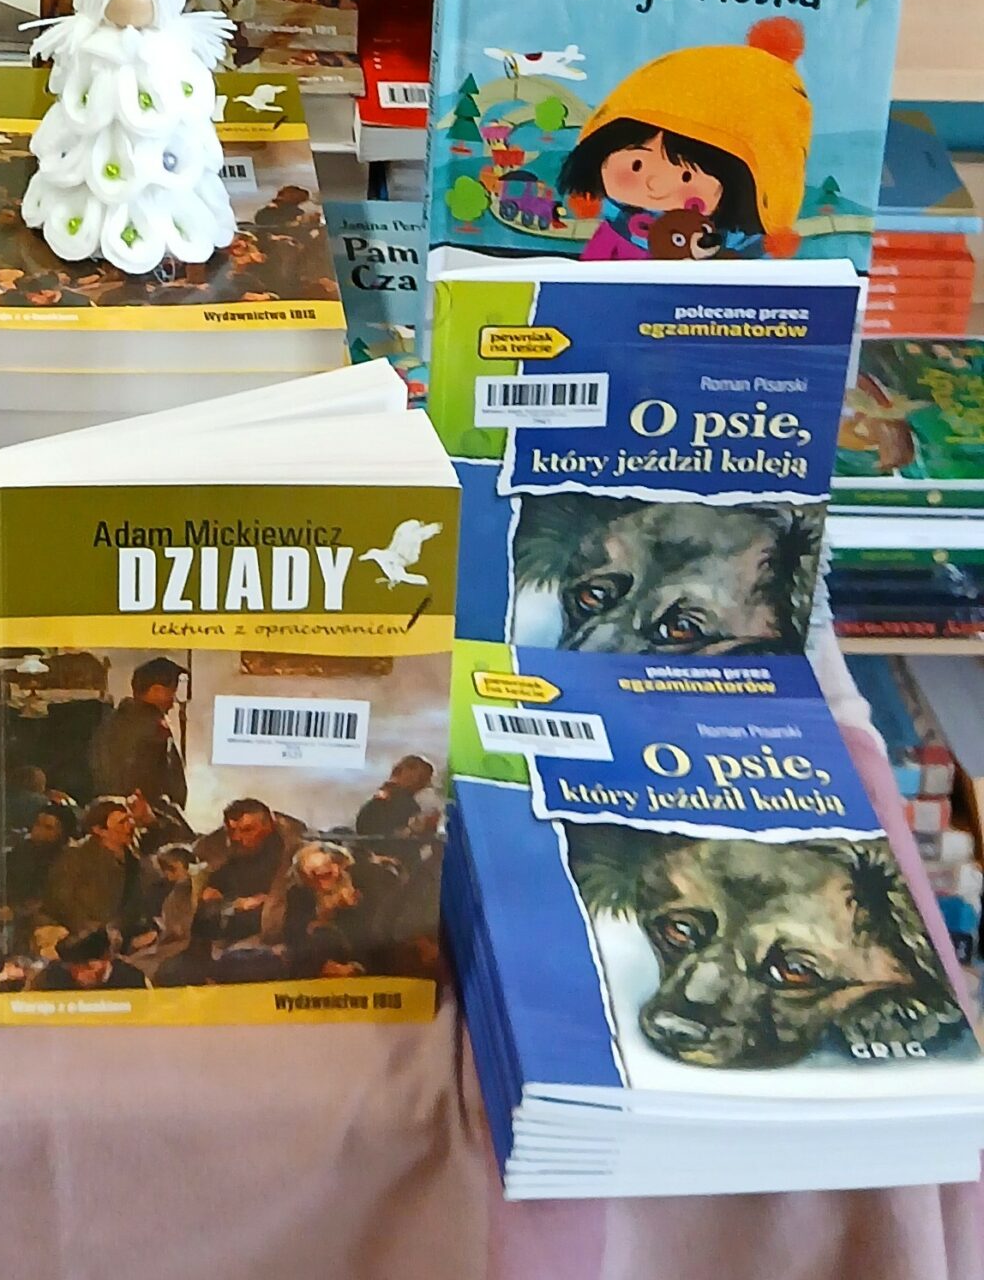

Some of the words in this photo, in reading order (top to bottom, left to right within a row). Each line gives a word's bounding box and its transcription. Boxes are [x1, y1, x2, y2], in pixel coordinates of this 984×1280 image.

[203, 310, 287, 323] Wydawnictwo
[675, 305, 757, 321] polecane
[759, 307, 809, 322] przez
[639, 322, 808, 339] egzaminatorów
[700, 376, 750, 392] Roman
[630, 399, 677, 437] O
[691, 401, 812, 446] psie,
[532, 448, 607, 476] który
[613, 448, 713, 478] jeździł
[721, 449, 808, 480] koleją
[94, 521, 172, 548] Adam
[185, 520, 343, 547] Mickiewicz
[118, 547, 354, 612] DZIADY
[151, 621, 225, 637] lektura
[254, 622, 407, 638] opracowaniem
[643, 743, 692, 778] O
[703, 747, 831, 786] psie,
[559, 779, 639, 810] który
[648, 785, 745, 812] jeździł
[755, 787, 847, 817] koleją
